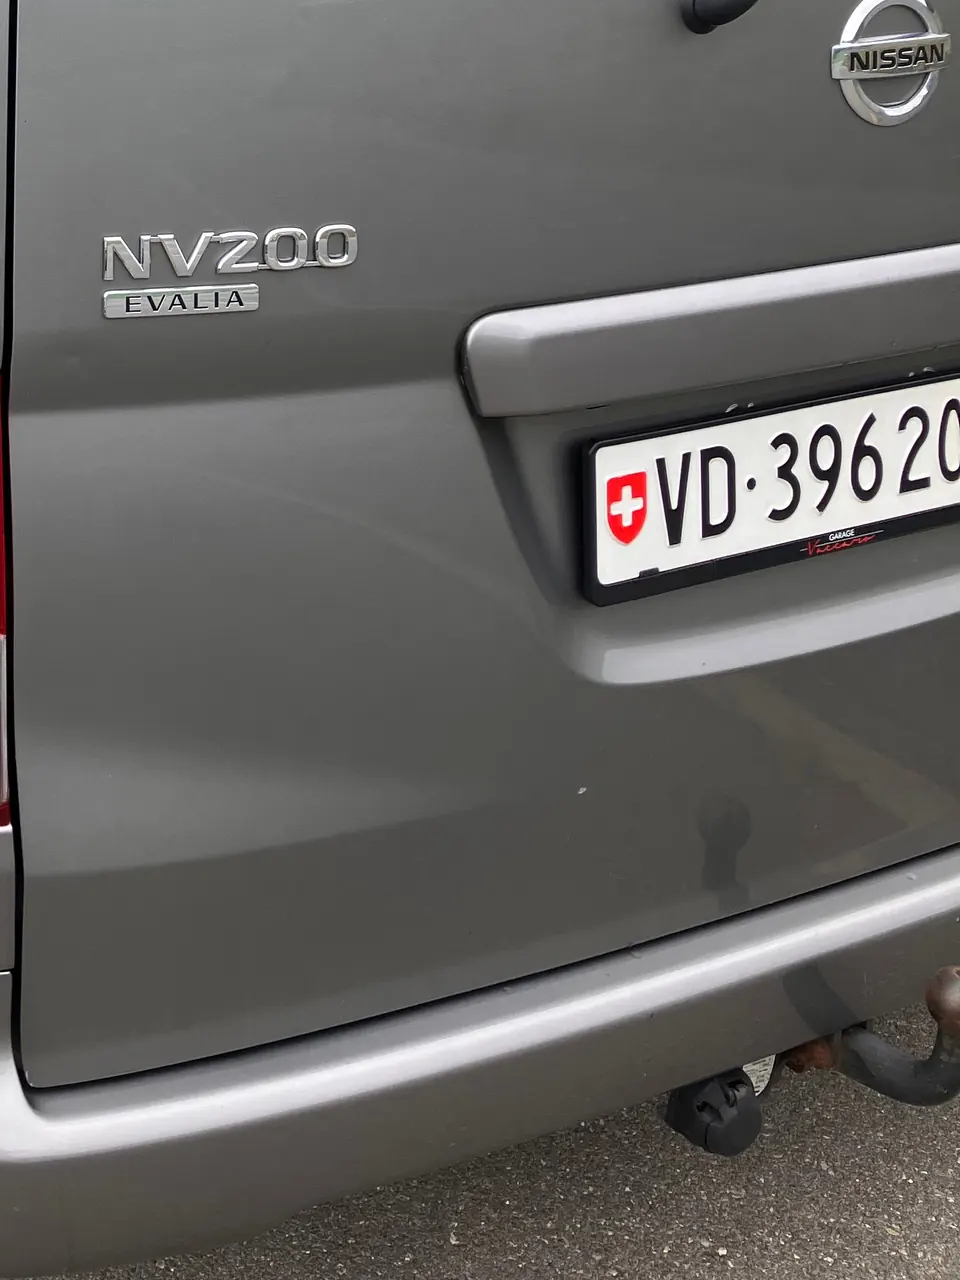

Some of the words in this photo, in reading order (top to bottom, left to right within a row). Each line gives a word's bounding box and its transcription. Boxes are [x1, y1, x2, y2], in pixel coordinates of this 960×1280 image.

[849, 43, 944, 71] NISSAN
[103, 224, 358, 280] NV200
[125, 290, 245, 313] EVALIA
[828, 528, 855, 541] GARAGE
